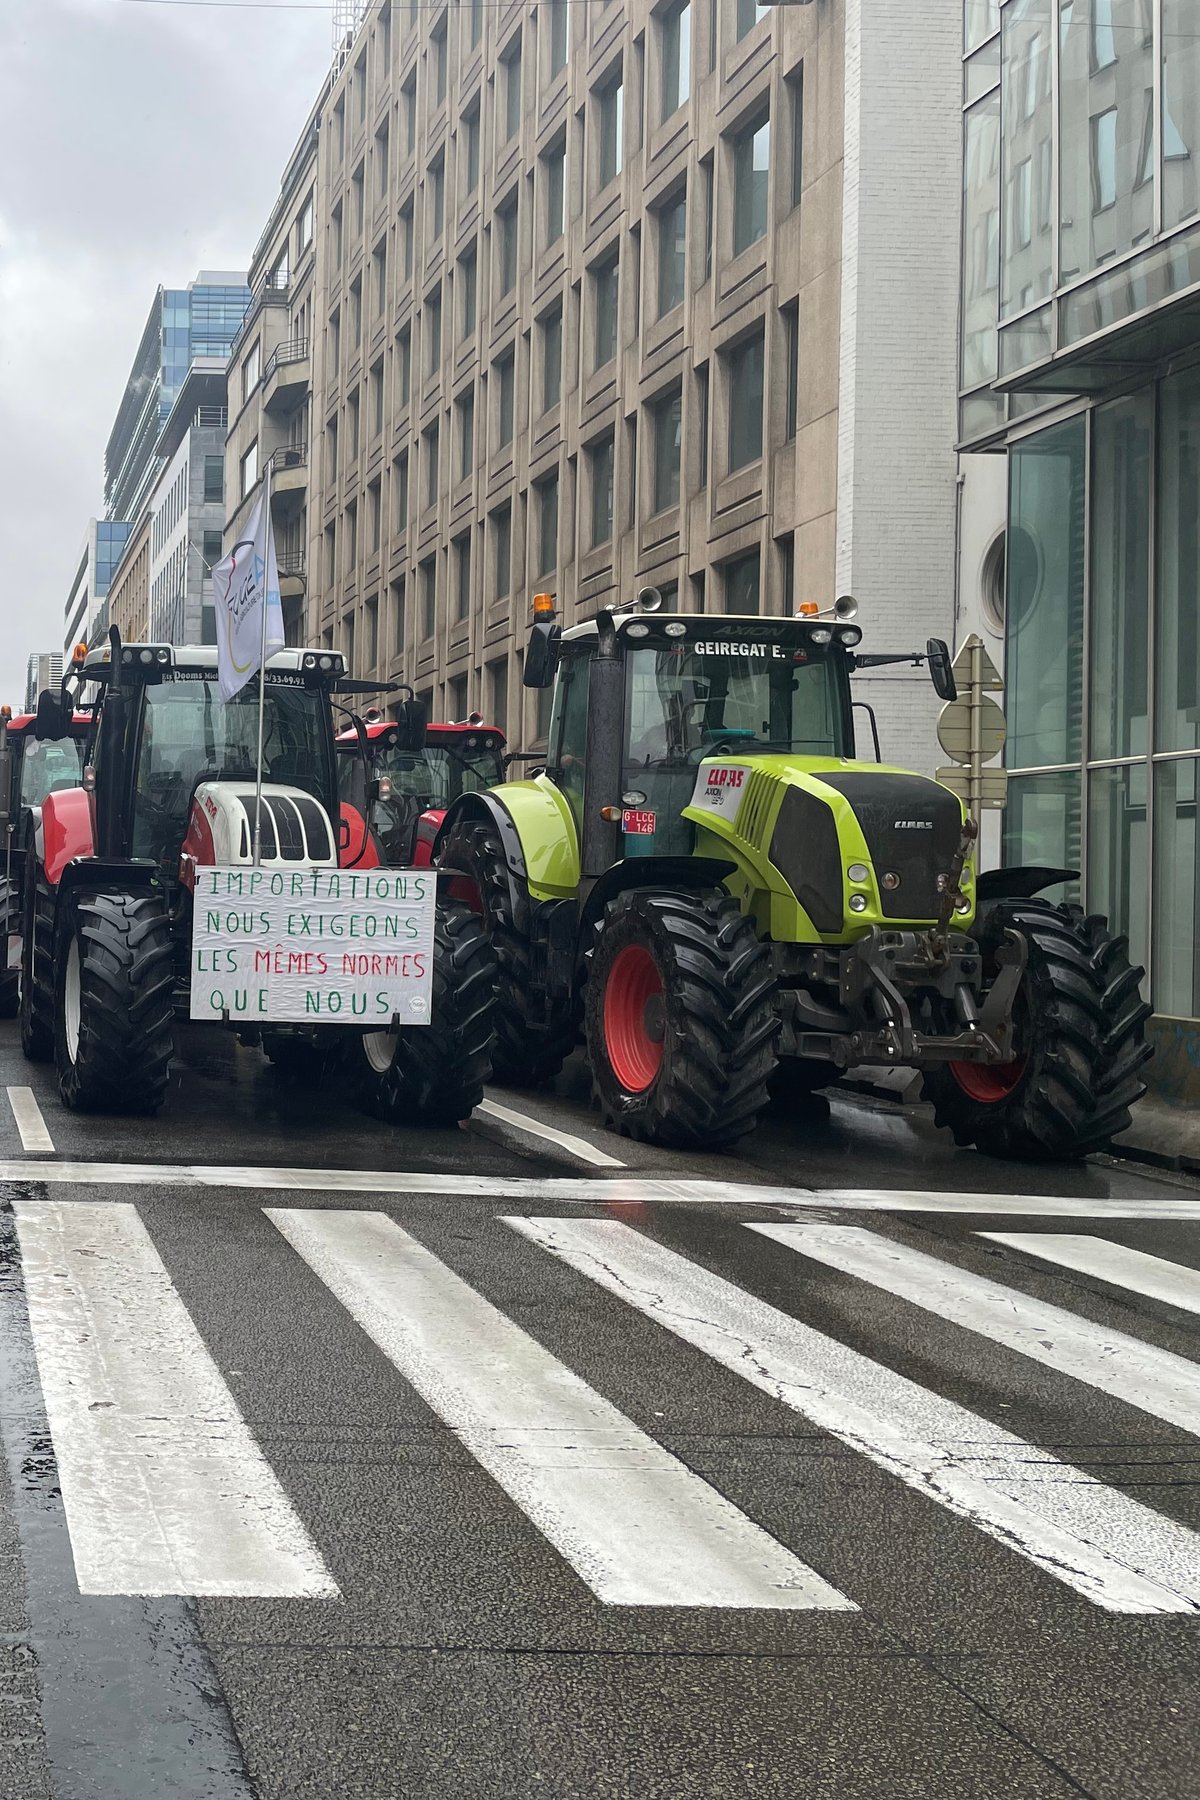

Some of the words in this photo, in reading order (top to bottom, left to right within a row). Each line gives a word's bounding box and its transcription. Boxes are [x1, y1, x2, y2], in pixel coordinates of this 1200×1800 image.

[713, 625, 785, 637] AXION
[694, 641, 767, 657] GEIREGAT
[772, 644, 786, 659] E.
[174, 670, 203, 680] Dooms
[707, 768, 745, 788] CLAAS
[704, 787, 722, 797] AXION
[624, 811, 654, 823] G-LCC
[636, 823, 654, 833] 146
[209, 871, 426, 901] IMPORTATIONS
[207, 910, 271, 935] NOUS
[287, 912, 419, 939] EXIGEONS
[197, 949, 239, 973] LES
[254, 943, 328, 975] MÊMES
[342, 952, 427, 979] NORMES
[209, 988, 270, 1013] QUE
[305, 990, 390, 1015] NOUS
